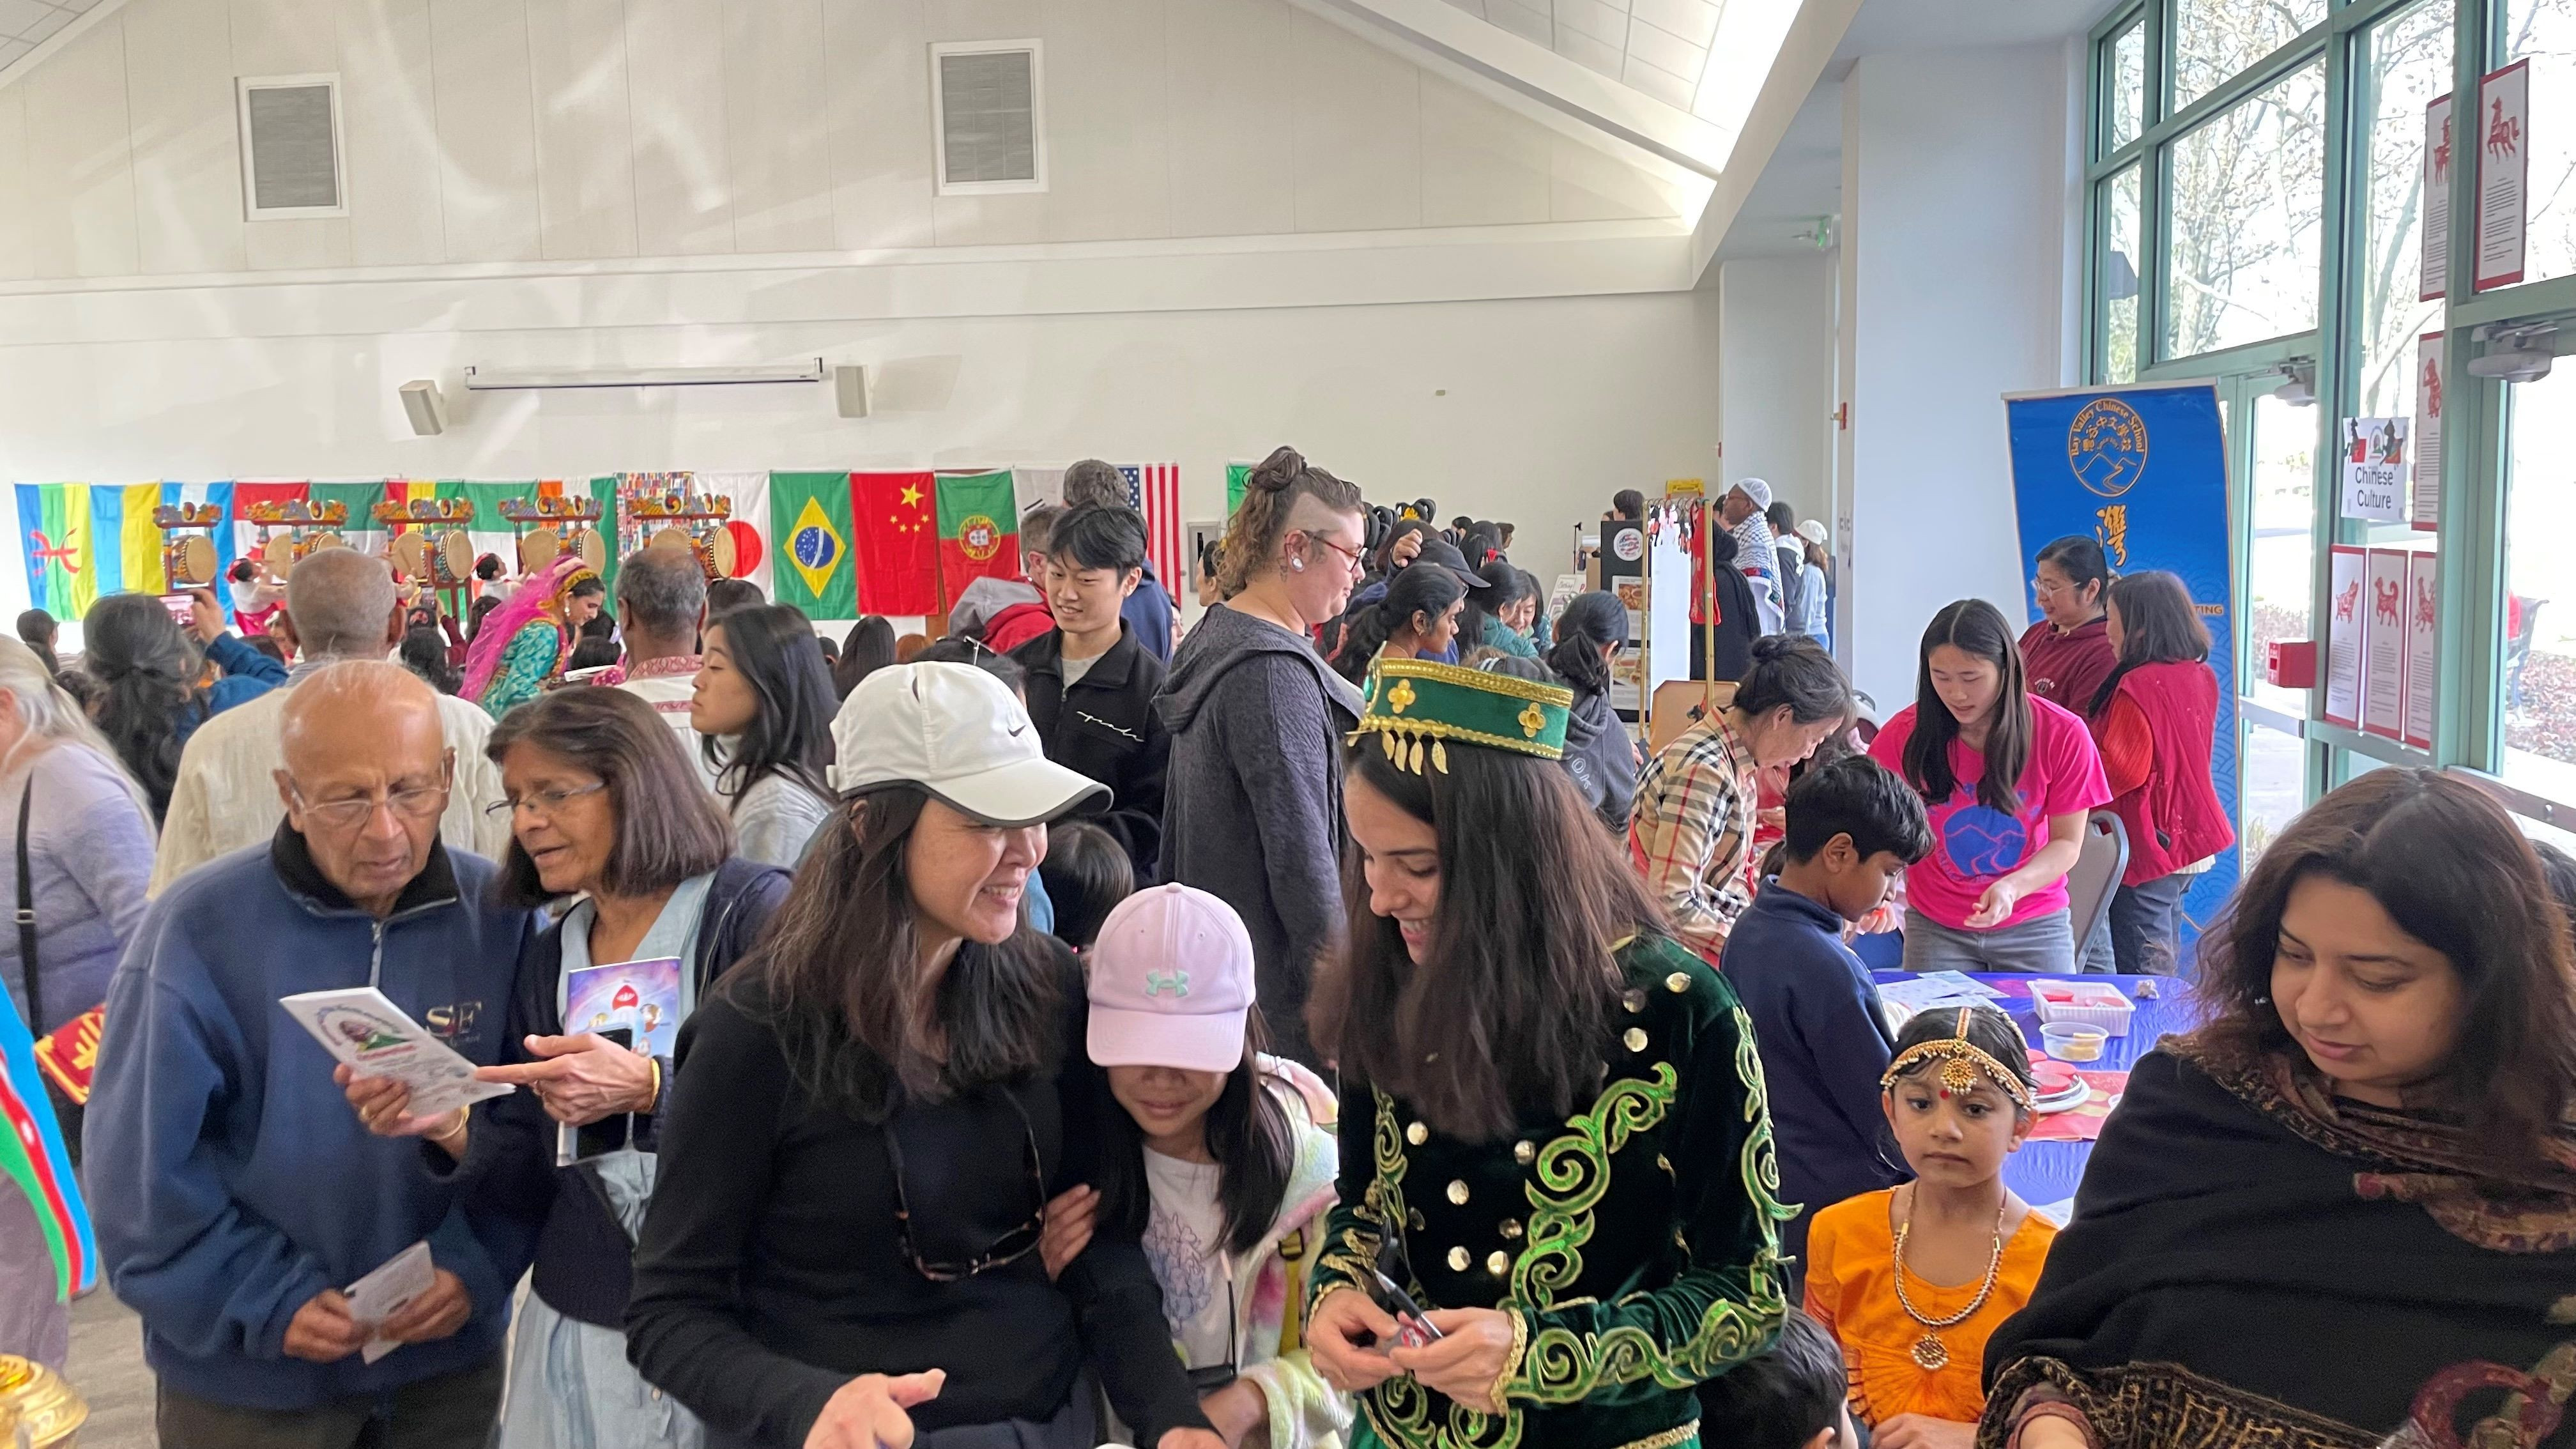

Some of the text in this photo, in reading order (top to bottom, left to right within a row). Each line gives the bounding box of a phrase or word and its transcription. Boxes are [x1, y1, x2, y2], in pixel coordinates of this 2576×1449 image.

[2096, 401, 2129, 418] Chinese
[2073, 409, 2094, 432] Valley
[2128, 416, 2145, 452] School
[2071, 436, 2082, 456] Bay
[2355, 466, 2393, 486] Chinese
[2357, 489, 2392, 509] Culture
[2194, 604, 2223, 615] TING
